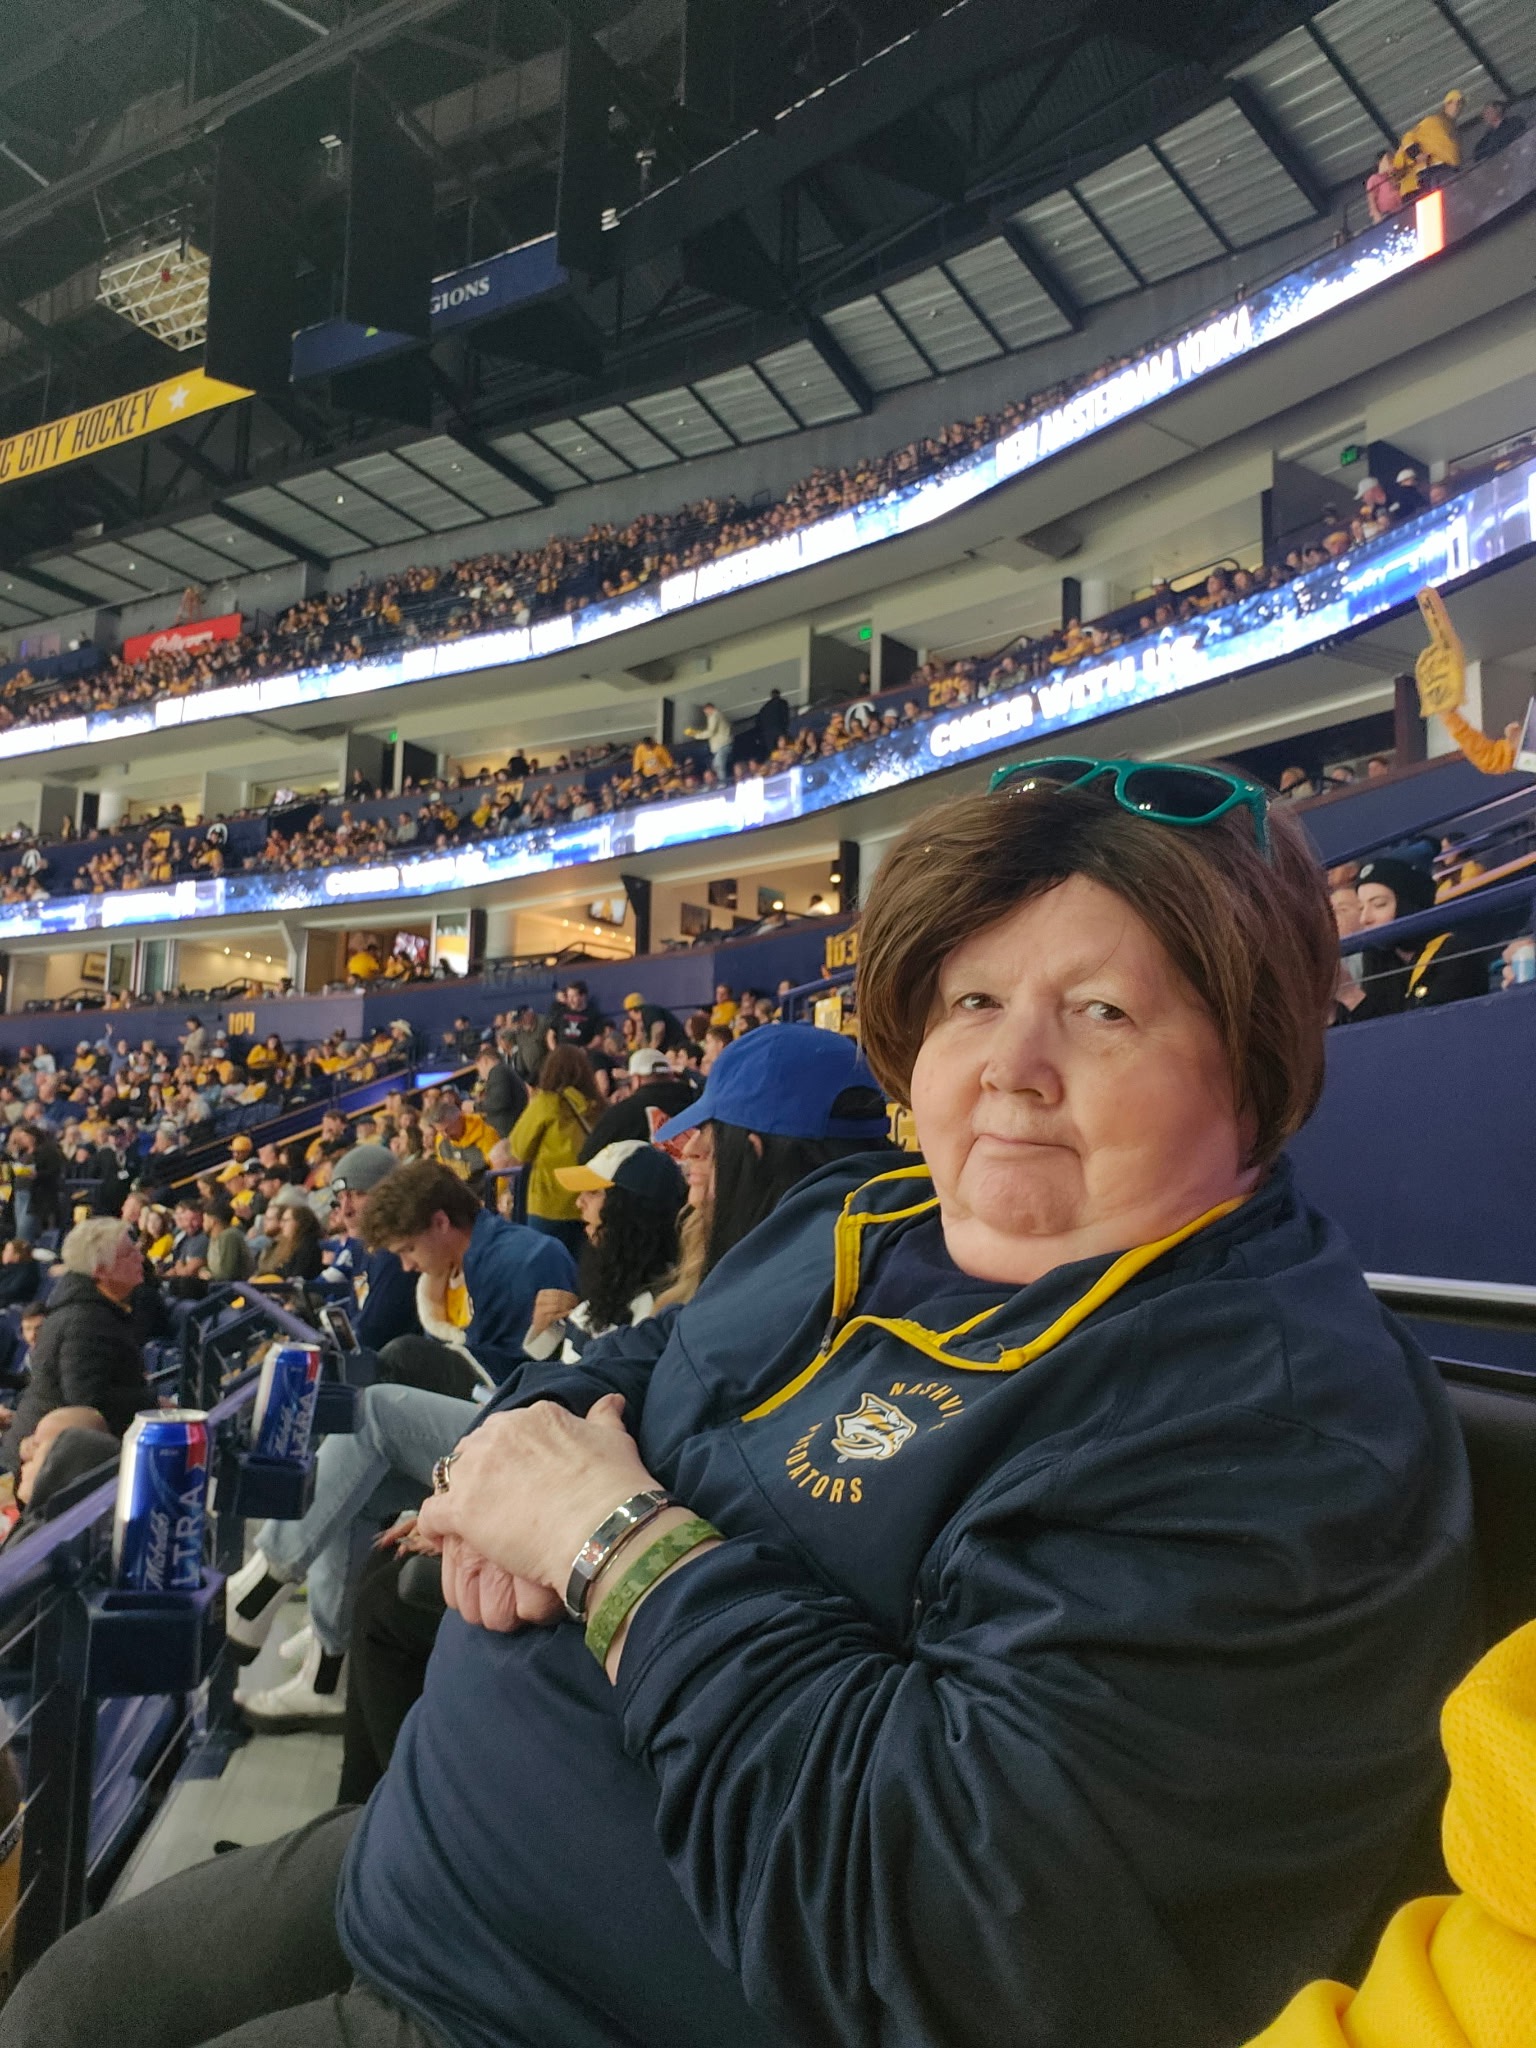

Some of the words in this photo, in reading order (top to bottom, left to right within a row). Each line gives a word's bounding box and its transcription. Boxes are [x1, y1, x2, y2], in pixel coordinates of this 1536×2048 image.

[18, 420, 69, 472] CITY
[71, 387, 159, 455] HOCKEY
[929, 695, 1034, 757] CHEER
[1037, 656, 1137, 719] WITH
[825, 932, 858, 969] 103
[228, 1011, 255, 1036] 104
